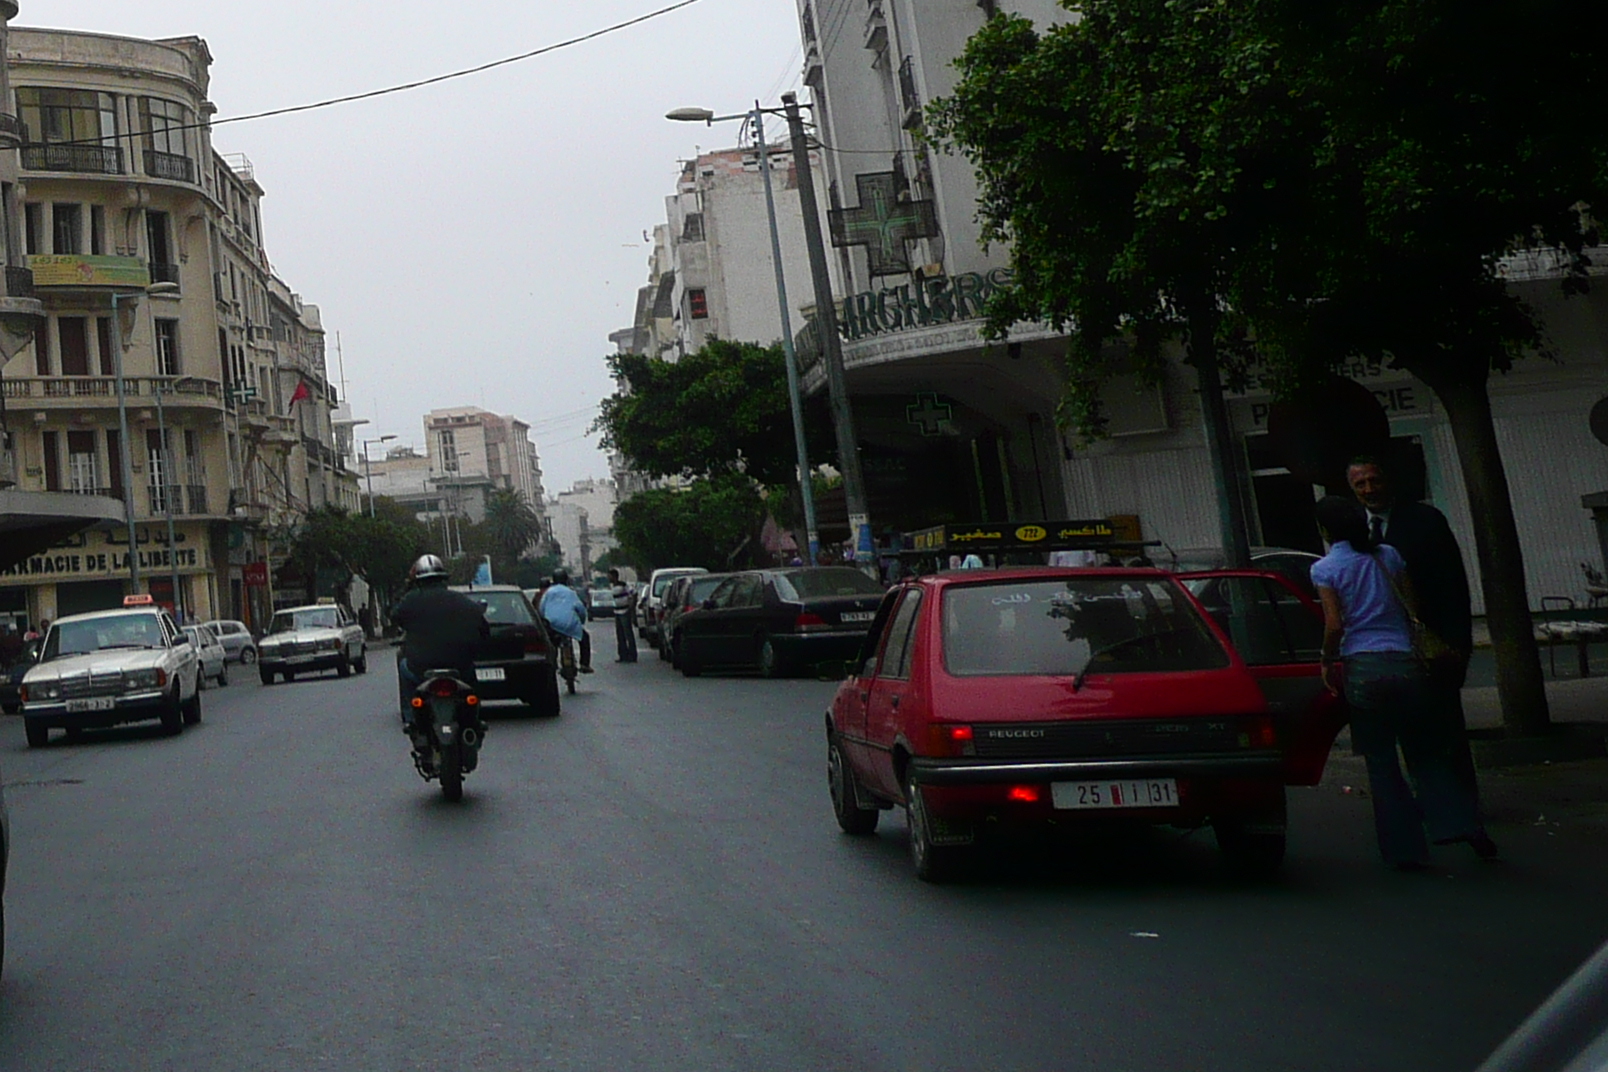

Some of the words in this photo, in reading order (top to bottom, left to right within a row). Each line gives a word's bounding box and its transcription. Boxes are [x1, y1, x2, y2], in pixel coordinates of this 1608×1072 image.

[86, 554, 106, 570] DE
[989, 729, 1045, 740] PEUGEOT
[1077, 784, 1101, 805] 25
[1152, 783, 1171, 803] 31
